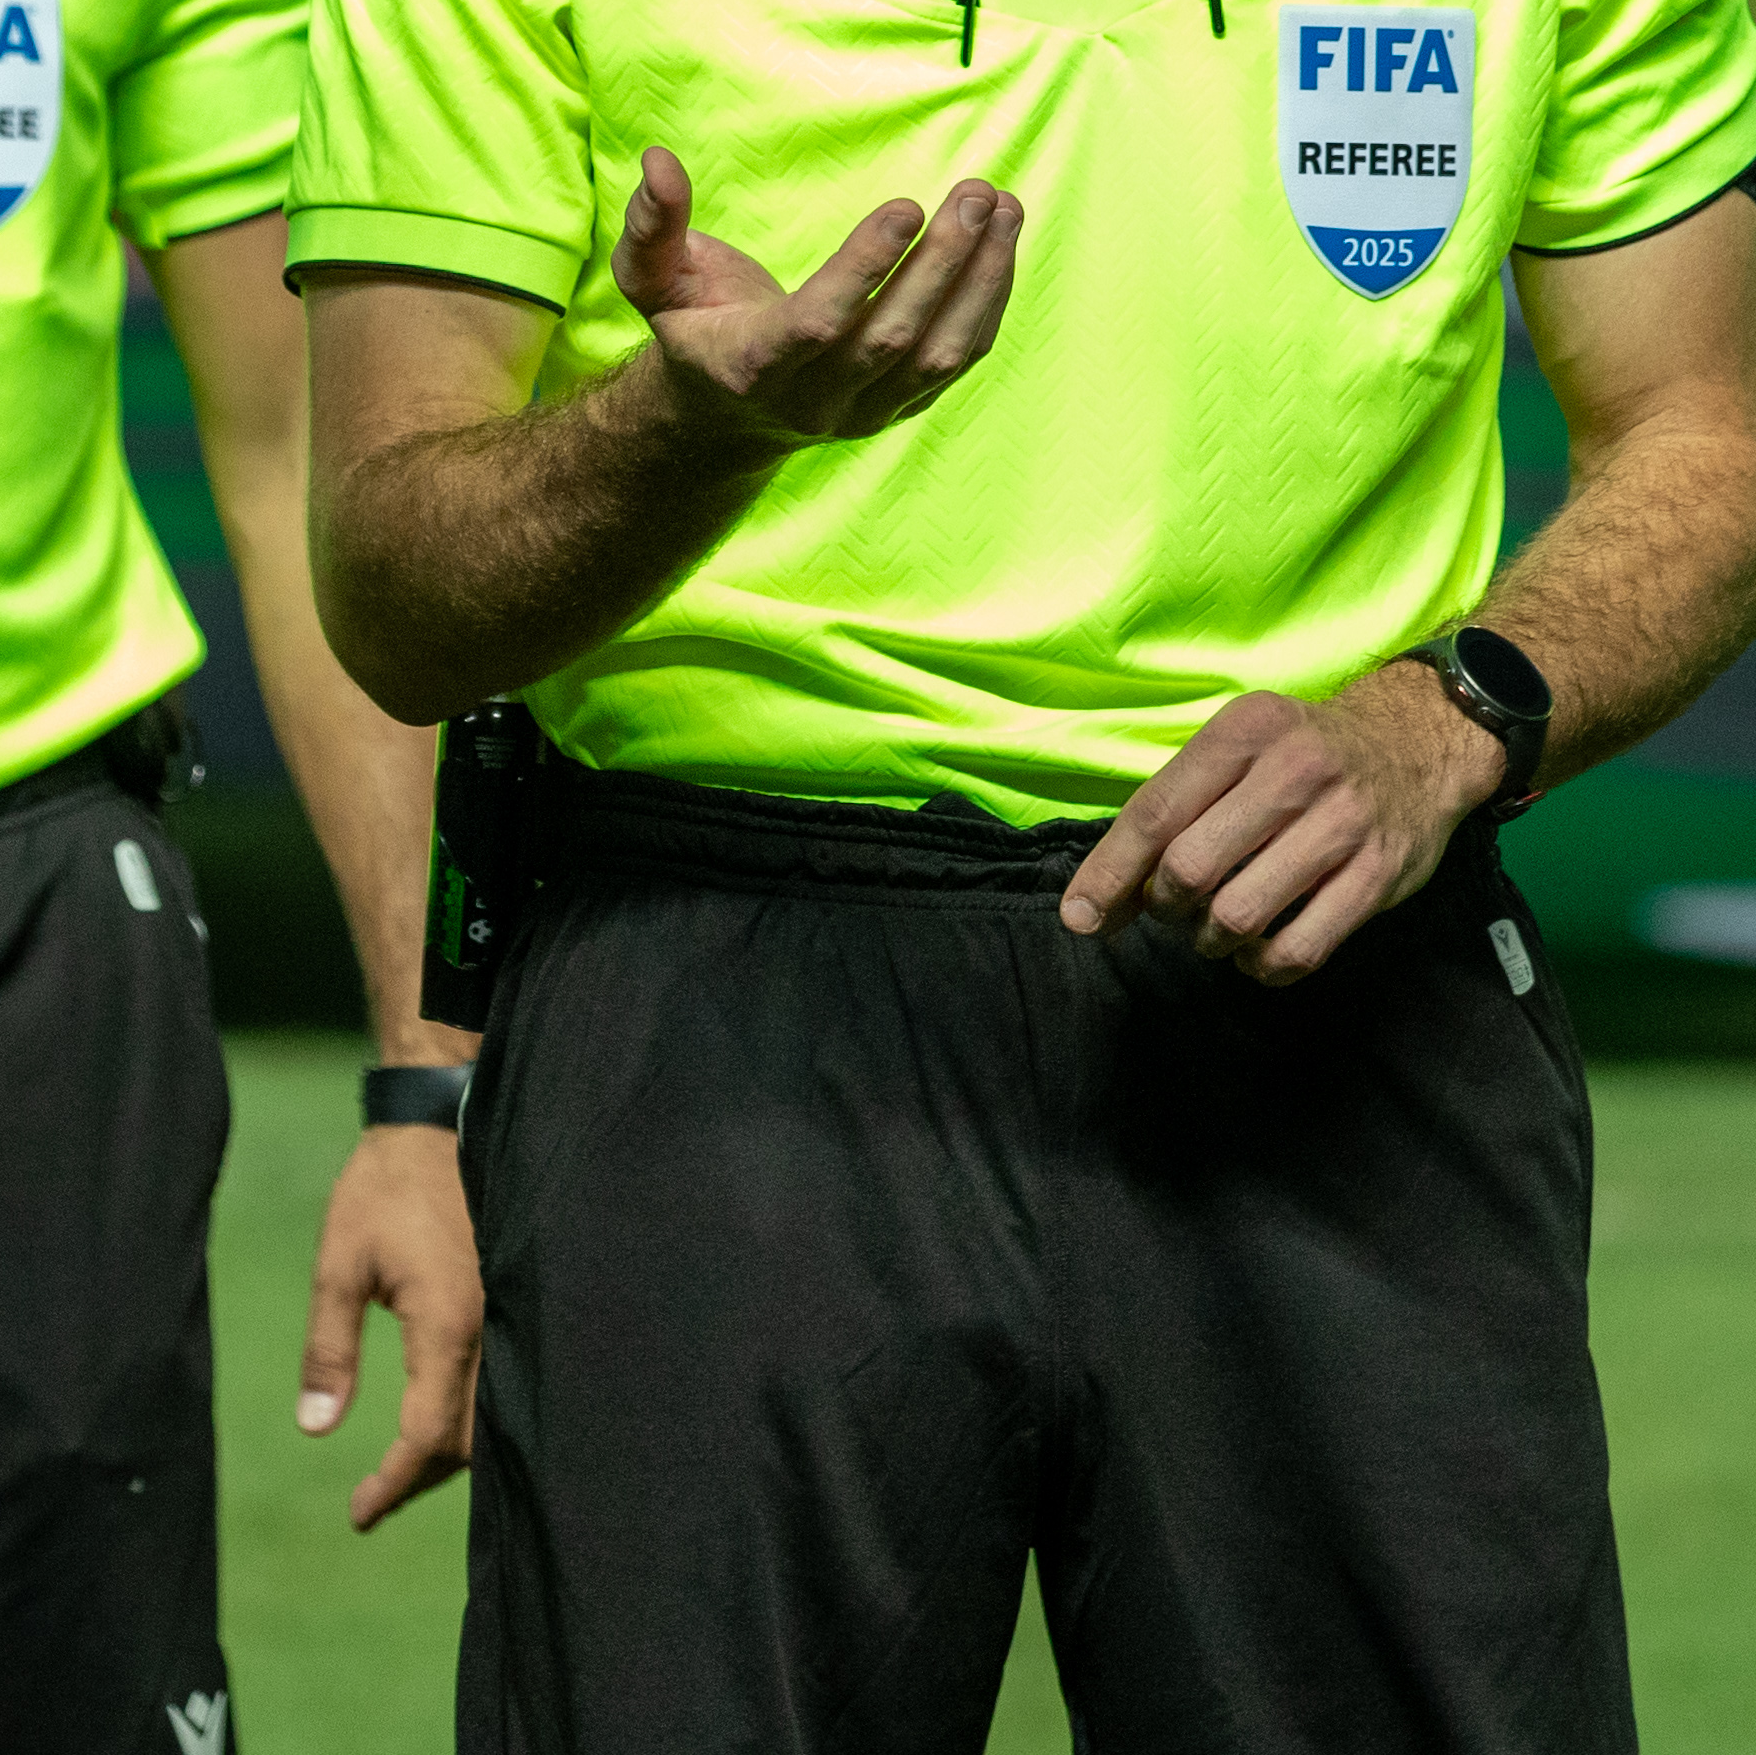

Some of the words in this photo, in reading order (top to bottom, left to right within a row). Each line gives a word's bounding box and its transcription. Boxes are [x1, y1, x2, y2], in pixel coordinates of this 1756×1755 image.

[1299, 25, 1459, 94] FIFA
[1298, 141, 1457, 177] REFEREE
[1342, 238, 1415, 267] 2025
